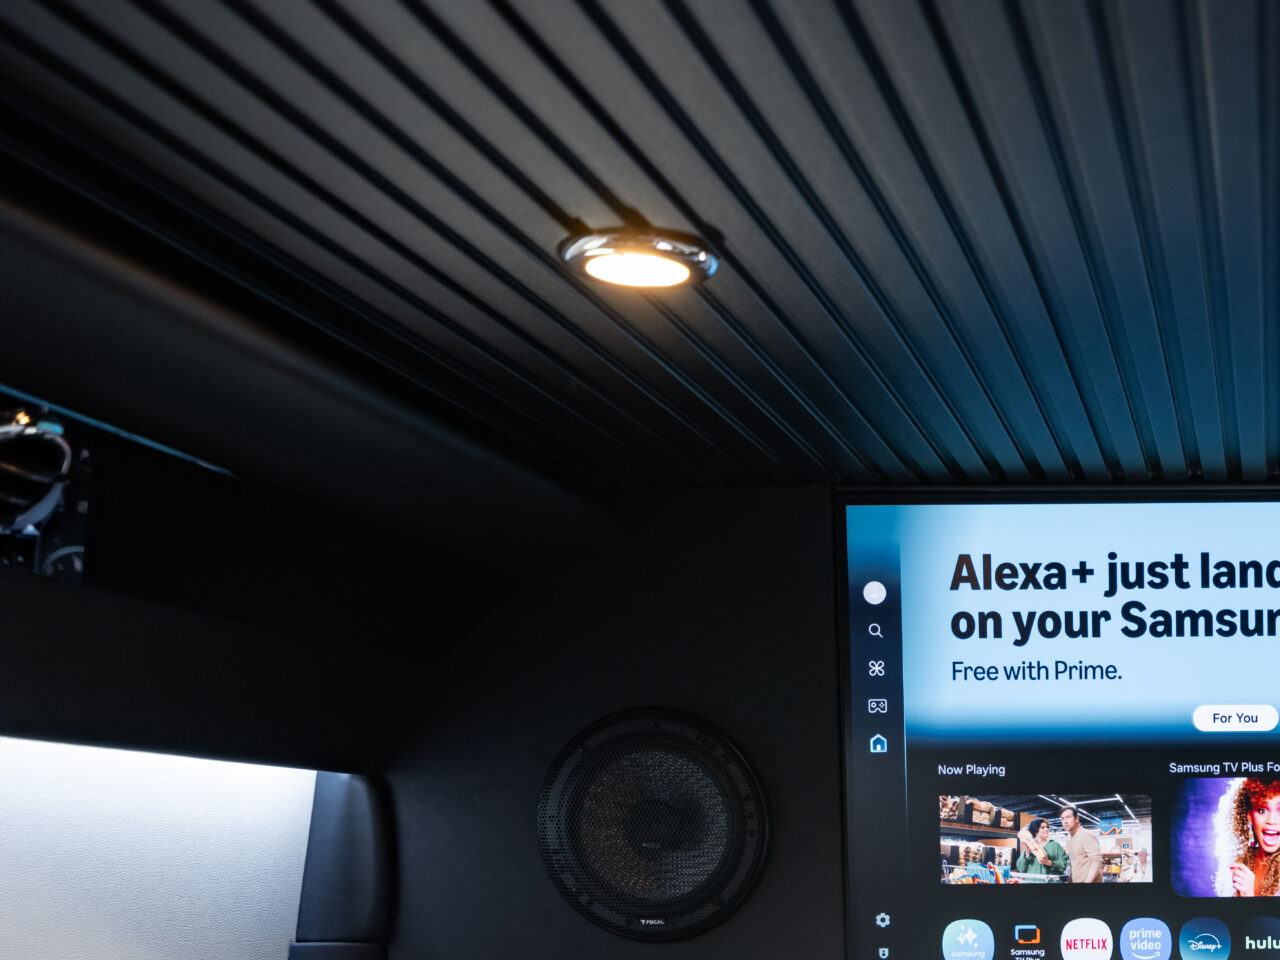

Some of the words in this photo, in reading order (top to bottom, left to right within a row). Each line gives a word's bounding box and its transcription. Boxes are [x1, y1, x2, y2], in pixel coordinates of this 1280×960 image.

[950, 554, 1094, 591] Alexa+
[1104, 552, 1191, 597] just
[951, 610, 1002, 639] on
[1012, 610, 1111, 646] your
[953, 661, 998, 680] Free
[1003, 661, 1049, 680] with
[1055, 661, 1122, 680] Prime.
[1213, 713, 1232, 723] For
[1236, 713, 1258, 723] You
[938, 765, 963, 775] Now
[966, 764, 1005, 777] Playing
[1169, 763, 1220, 775] Samsung
[1223, 762, 1238, 772] TV
[1241, 762, 1264, 772] Plus
[1129, 928, 1162, 940] prime
[1066, 938, 1108, 951] NETFLIX
[1130, 938, 1162, 950] video
[1010, 949, 1045, 957] Samsung
